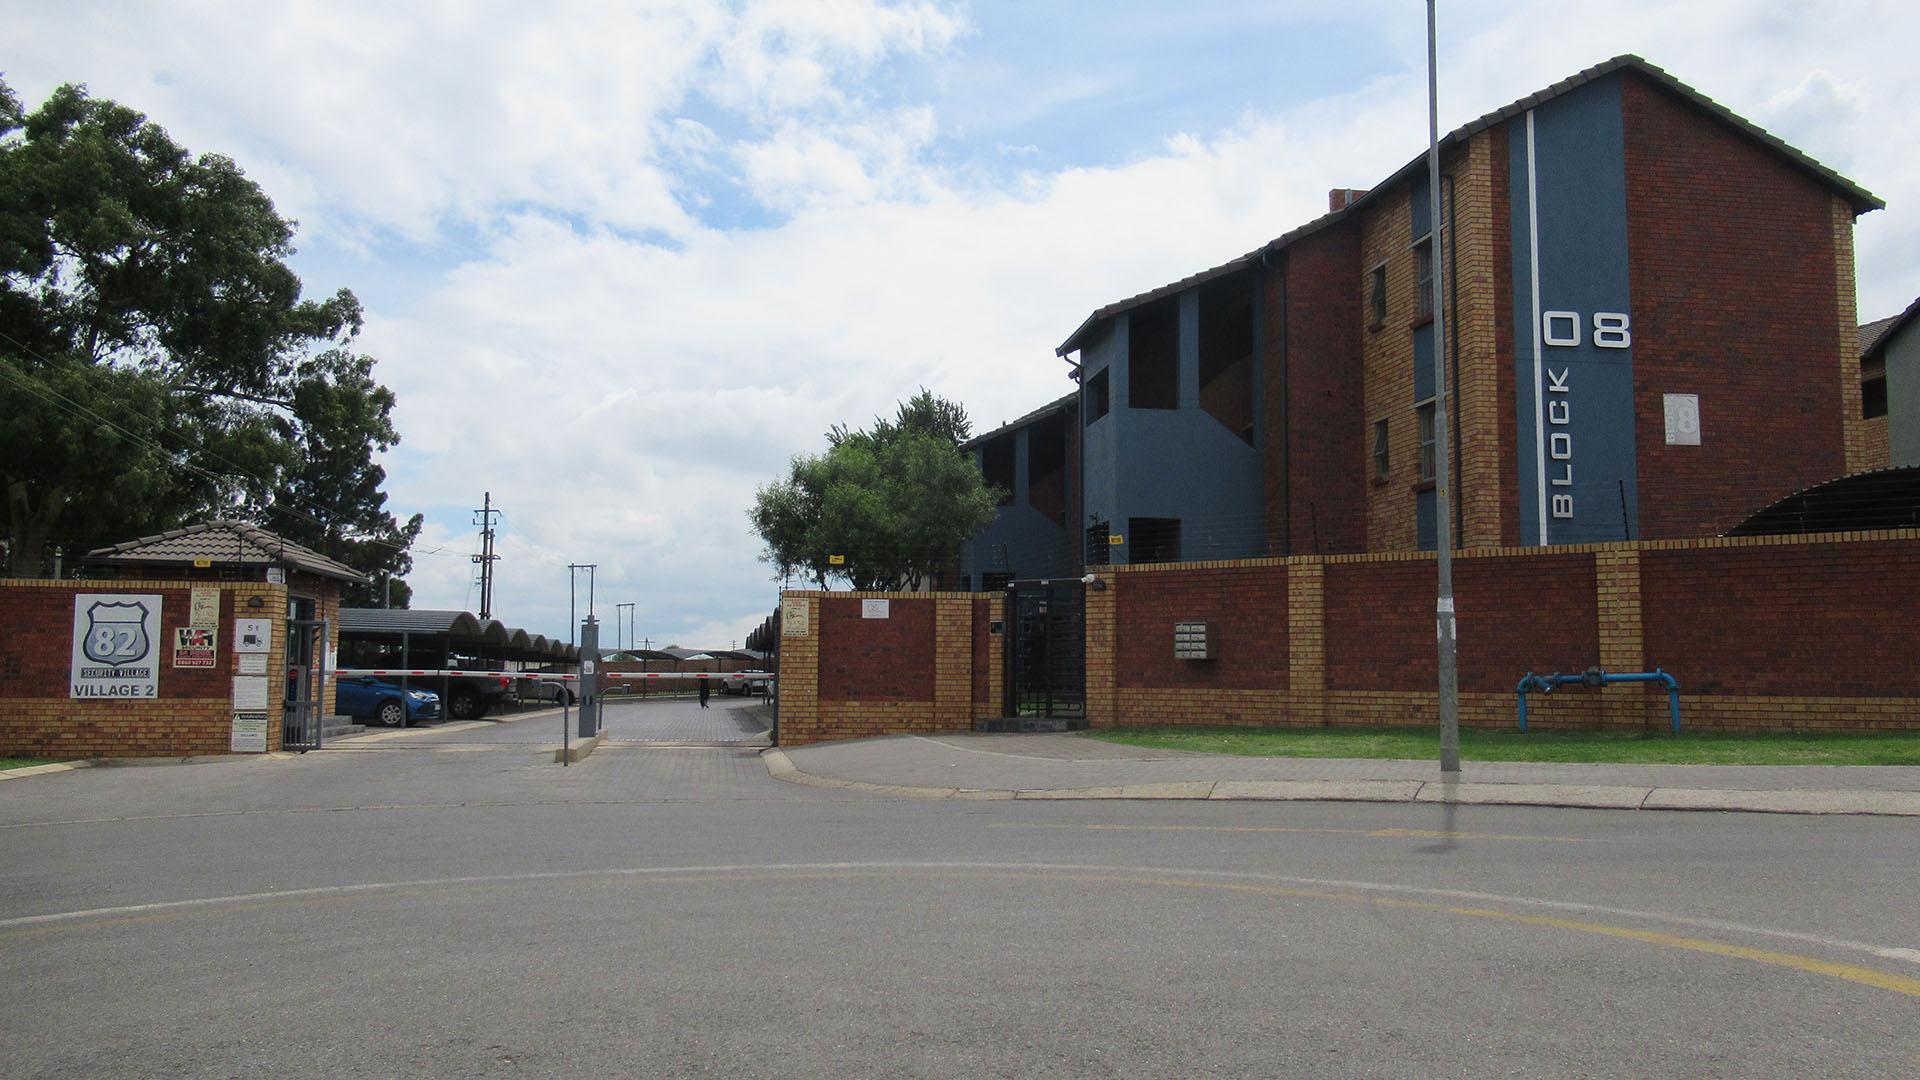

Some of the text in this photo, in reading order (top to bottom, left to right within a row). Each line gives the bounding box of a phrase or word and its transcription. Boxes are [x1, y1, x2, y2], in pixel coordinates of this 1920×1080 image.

[1543, 310, 1631, 349] 08
[1548, 367, 1573, 518] BLOCK
[94, 626, 138, 657] 82
[178, 629, 214, 646] WAR
[83, 668, 149, 678] SECURITY VILLAGE
[74, 684, 154, 697] VILLAGE 2
